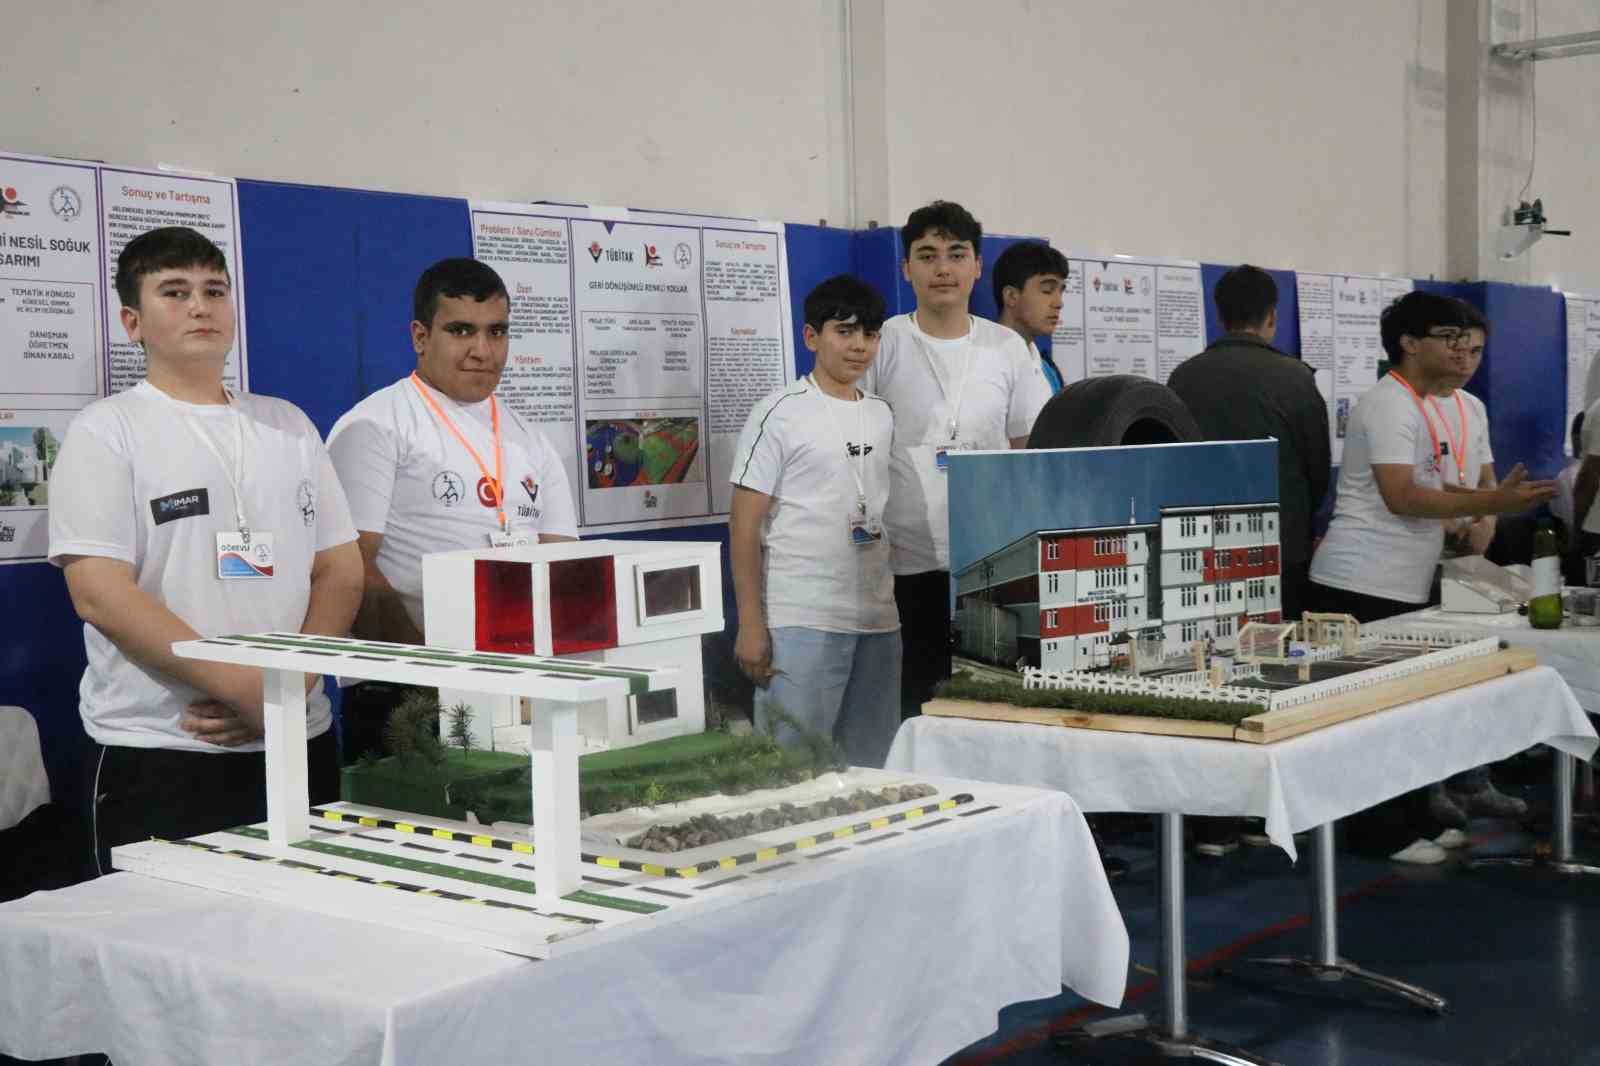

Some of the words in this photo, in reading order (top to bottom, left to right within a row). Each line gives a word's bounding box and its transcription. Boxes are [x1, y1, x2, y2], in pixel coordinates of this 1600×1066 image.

[121, 185, 154, 201] Sonuç
[155, 190, 168, 200] ve
[168, 189, 211, 206] Tartışma
[8, 233, 48, 250] NESİL
[49, 237, 91, 254] SOĞUK
[605, 247, 635, 263] TÜBİTAK
[588, 280, 604, 290] GERİ
[11, 287, 44, 298] TEMATİK
[44, 289, 76, 299] KONUSU
[29, 330, 69, 340] DANIŞMAN
[28, 339, 69, 350] ÖĞRETMEN
